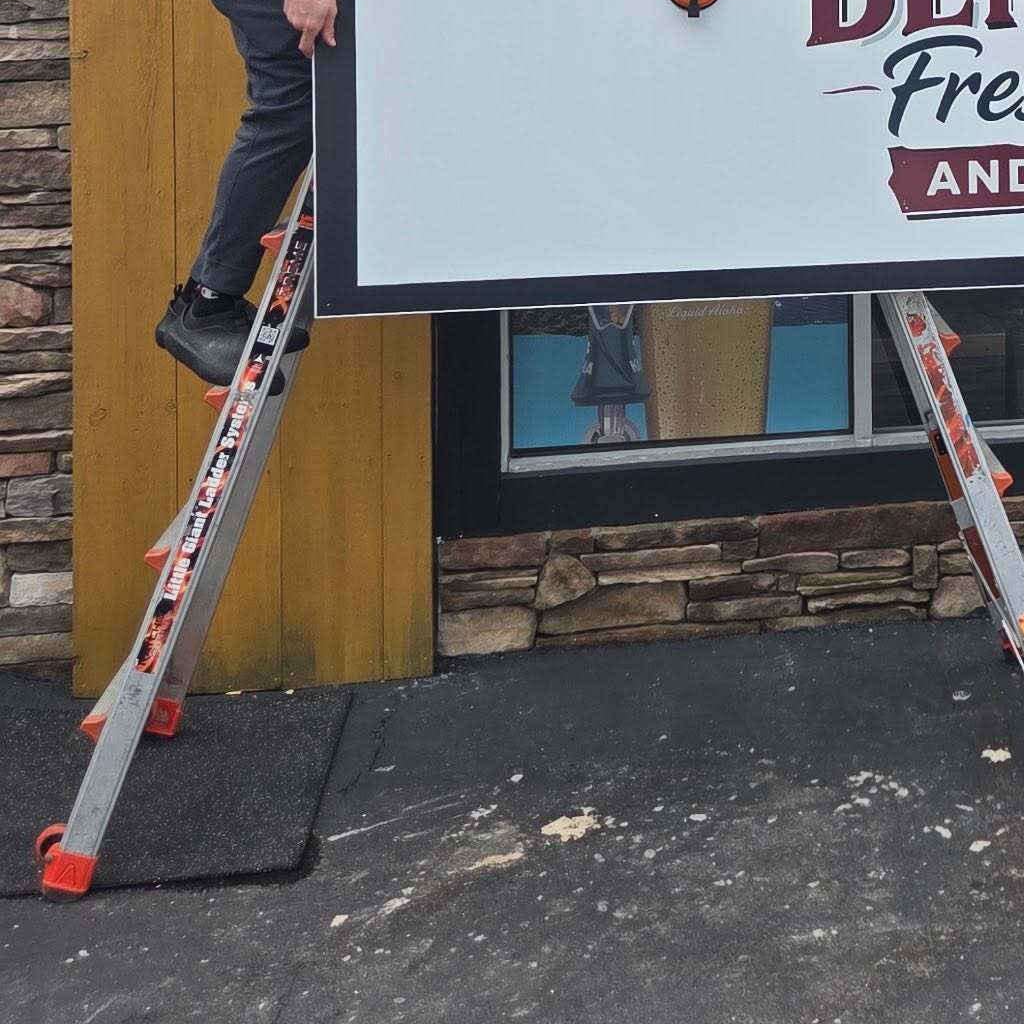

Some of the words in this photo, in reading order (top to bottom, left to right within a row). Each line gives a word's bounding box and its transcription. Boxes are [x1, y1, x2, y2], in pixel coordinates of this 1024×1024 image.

[164, 558, 191, 601] Little
[182, 511, 209, 554] Giant
[198, 452, 230, 508] Ladder
[221, 381, 256, 449] Systes
